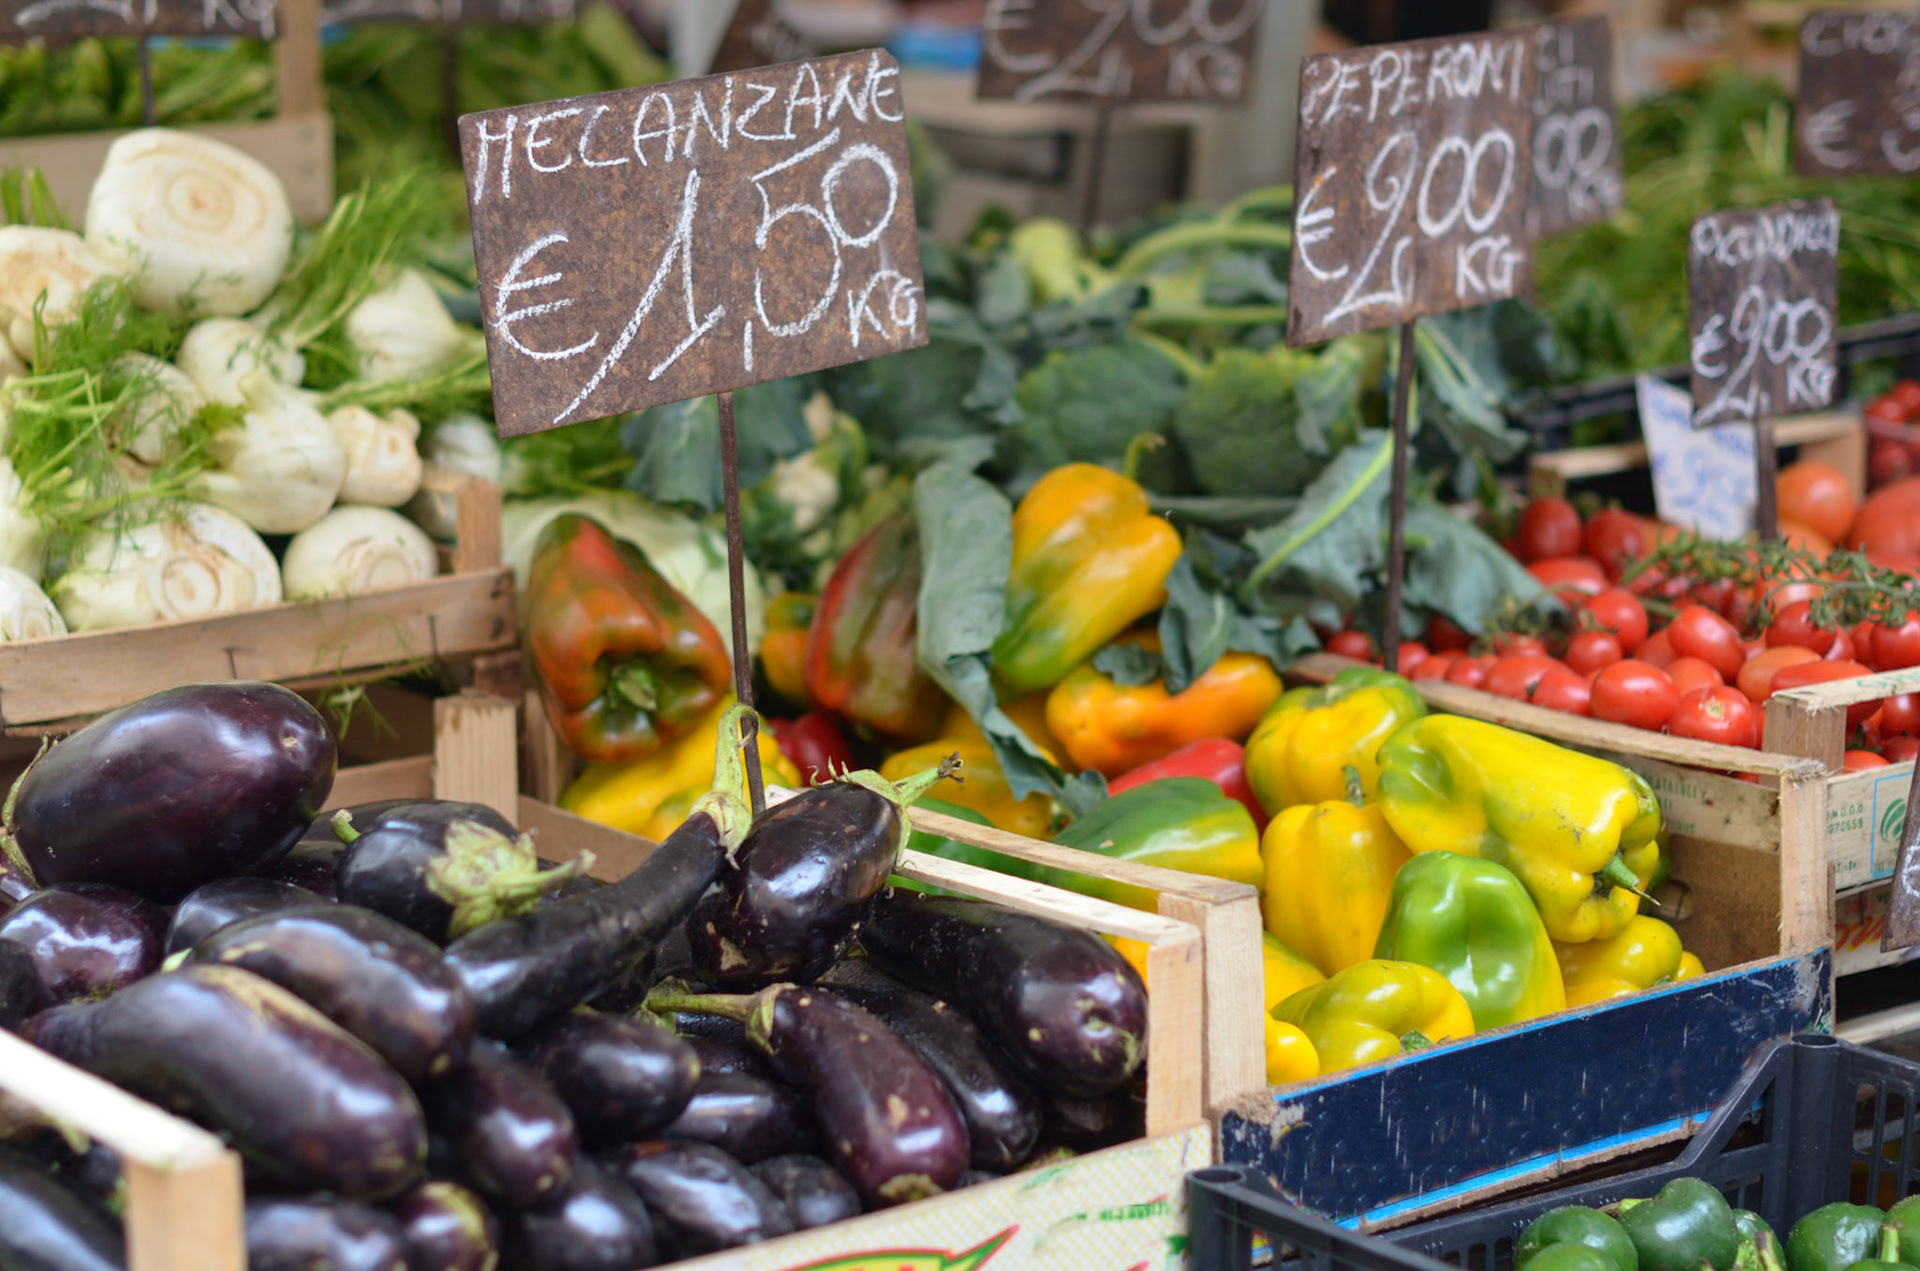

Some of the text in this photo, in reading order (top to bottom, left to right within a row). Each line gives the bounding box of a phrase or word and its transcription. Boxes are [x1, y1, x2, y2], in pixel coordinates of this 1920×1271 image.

[1300, 39, 1525, 129] PEPERONI
[493, 127, 922, 424] € 1,50 KG
[1295, 166, 1349, 281] €
[1455, 234, 1526, 299] KG
[1691, 313, 1729, 379] €
[1786, 356, 1838, 407] KG
